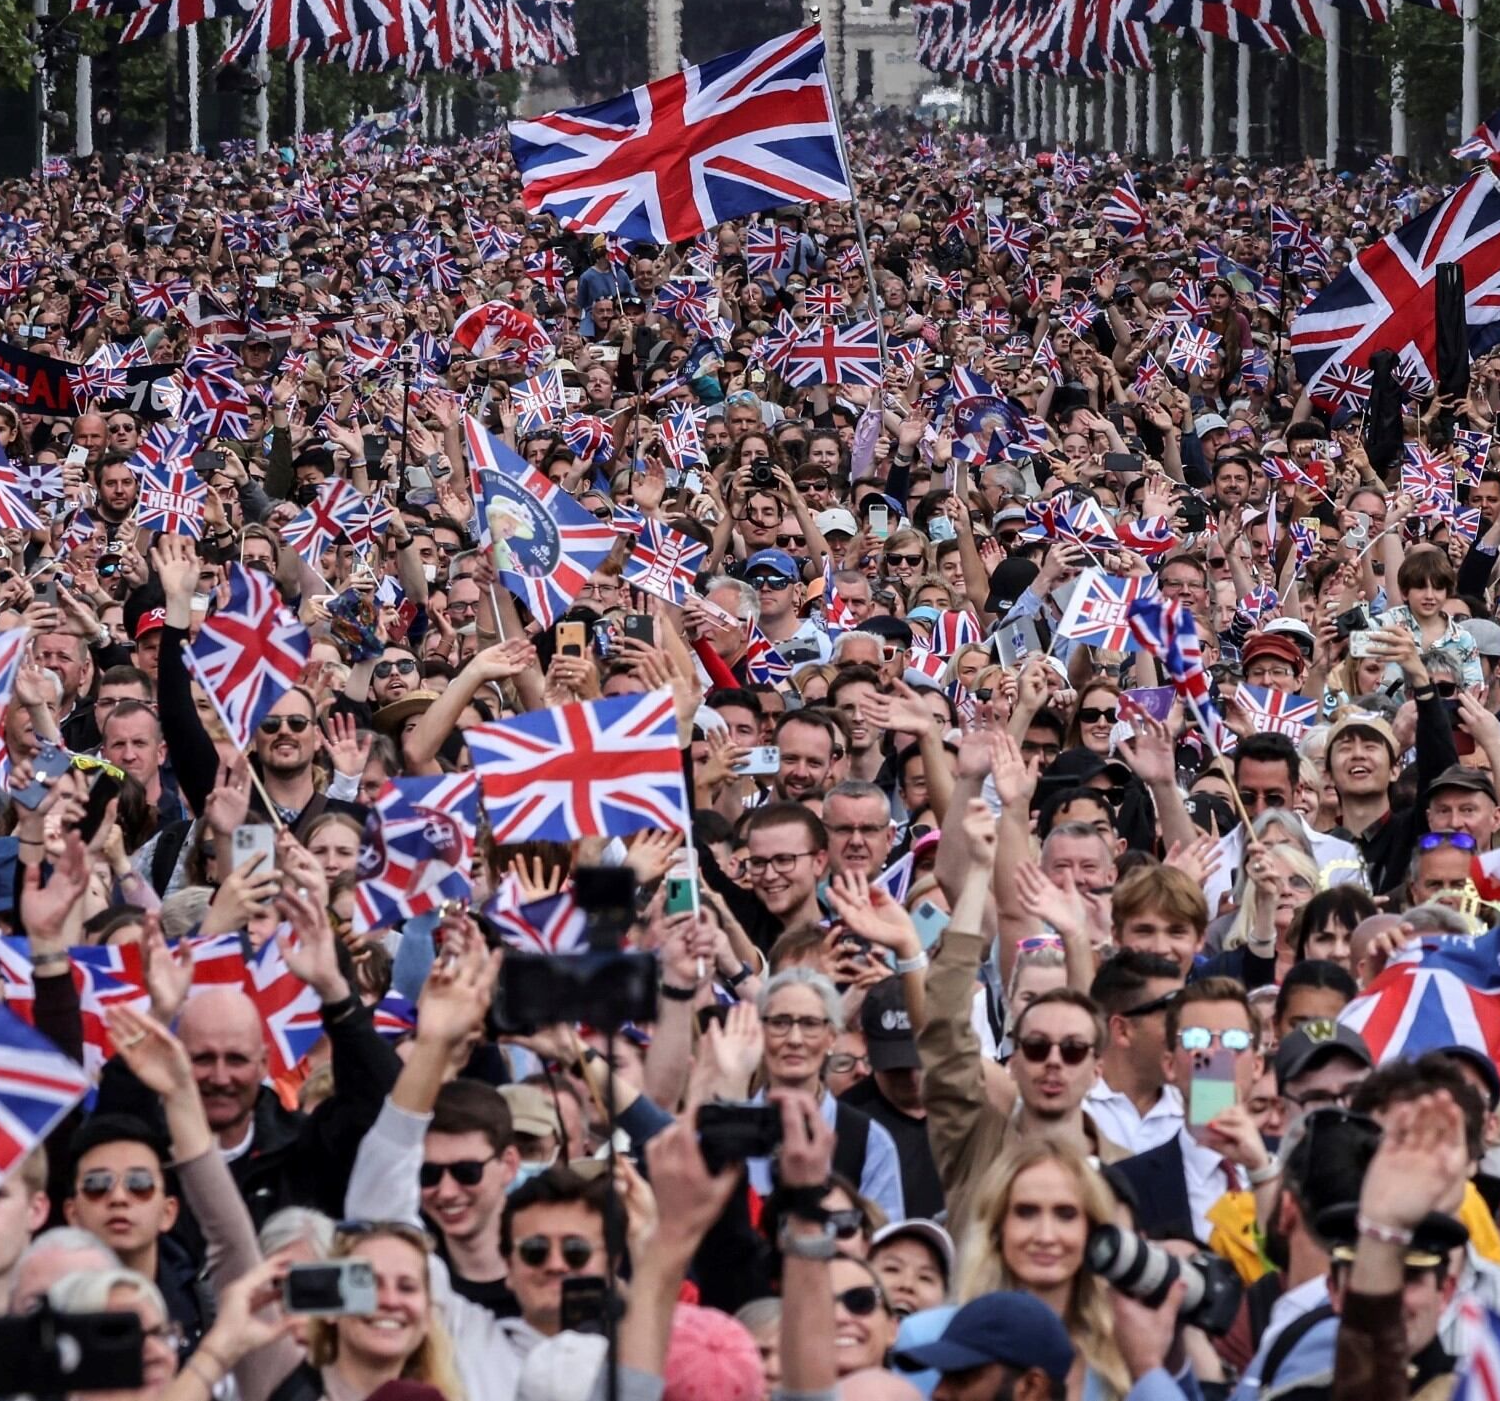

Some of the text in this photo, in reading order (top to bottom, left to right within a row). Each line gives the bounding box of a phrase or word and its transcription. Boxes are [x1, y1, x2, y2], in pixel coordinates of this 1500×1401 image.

[520, 389, 560, 414] HELLO!
[147, 490, 199, 518] HELLO!
[642, 537, 683, 598] HELLO!
